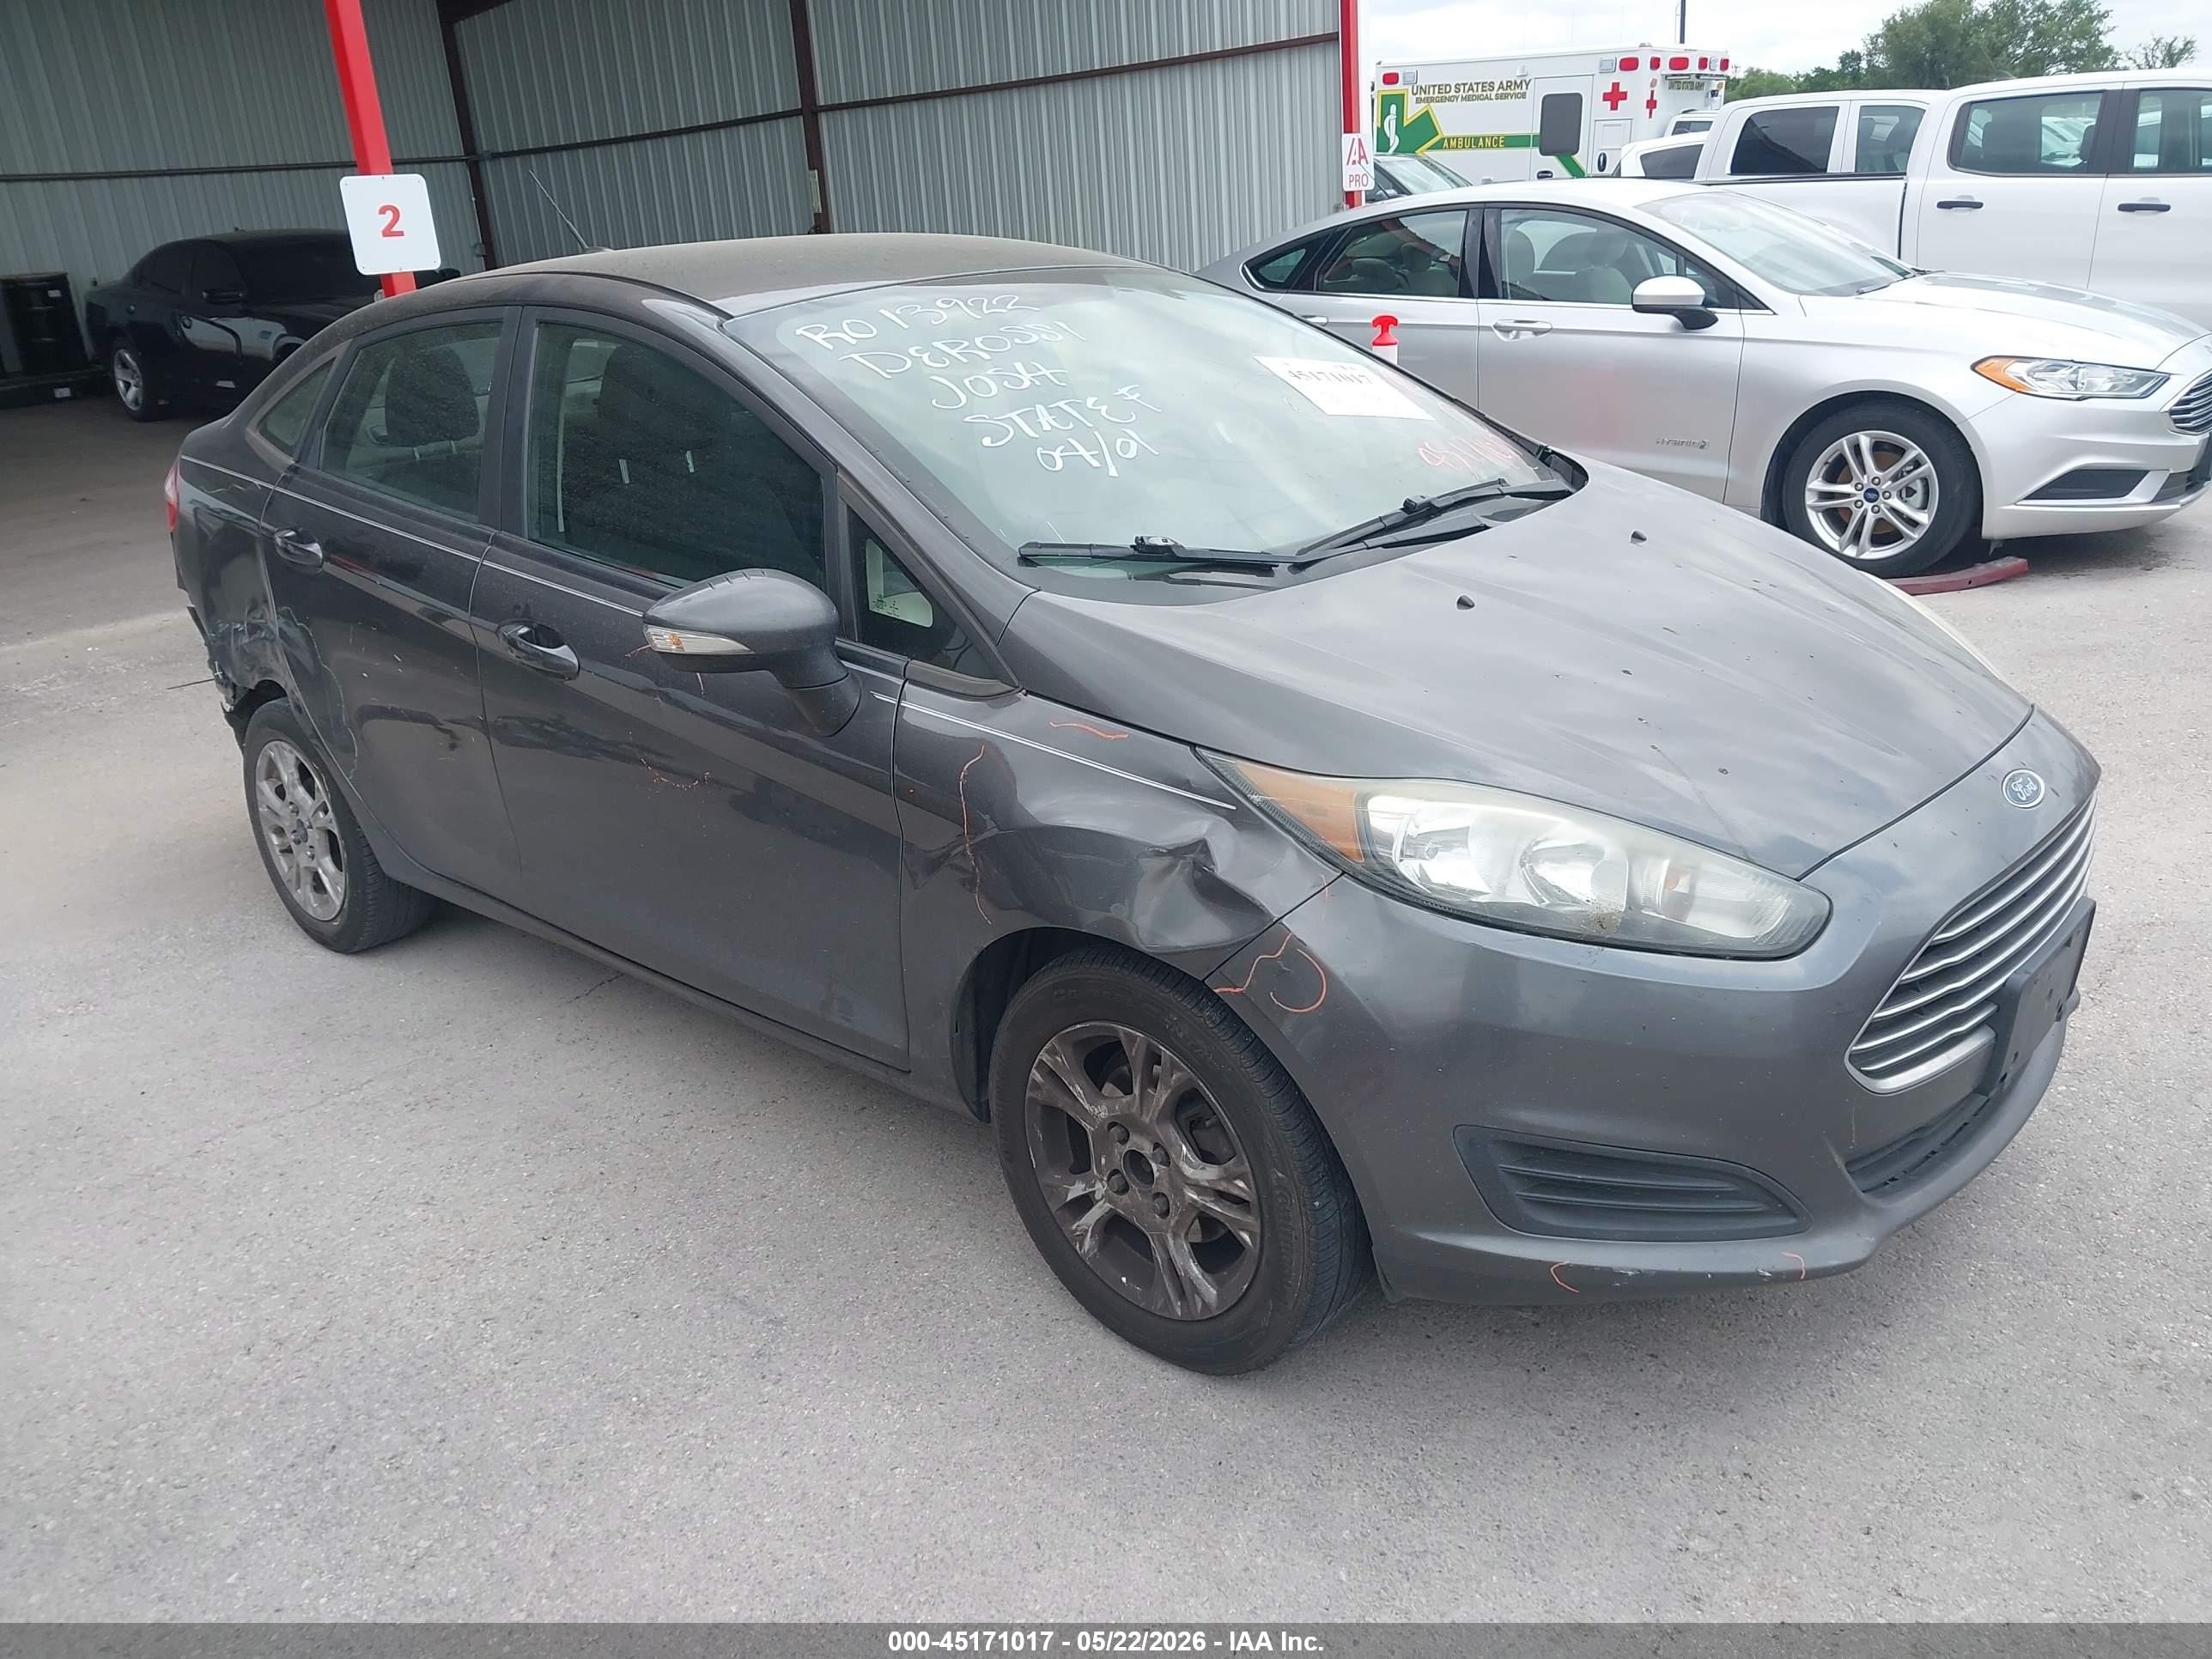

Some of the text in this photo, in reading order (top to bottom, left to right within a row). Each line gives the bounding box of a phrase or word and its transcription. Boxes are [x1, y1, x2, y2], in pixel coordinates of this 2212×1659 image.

[1412, 79, 1532, 95] UNITED STATES ARMY
[1415, 92, 1527, 104] EMERGENCY MEDICAL SERVICE
[1443, 136, 1505, 149] AMBULANCE
[1348, 173, 1369, 188] PRO
[378, 204, 404, 238] 2
[929, 361, 1069, 410] JOSH
[2011, 777, 2038, 801] Ford
